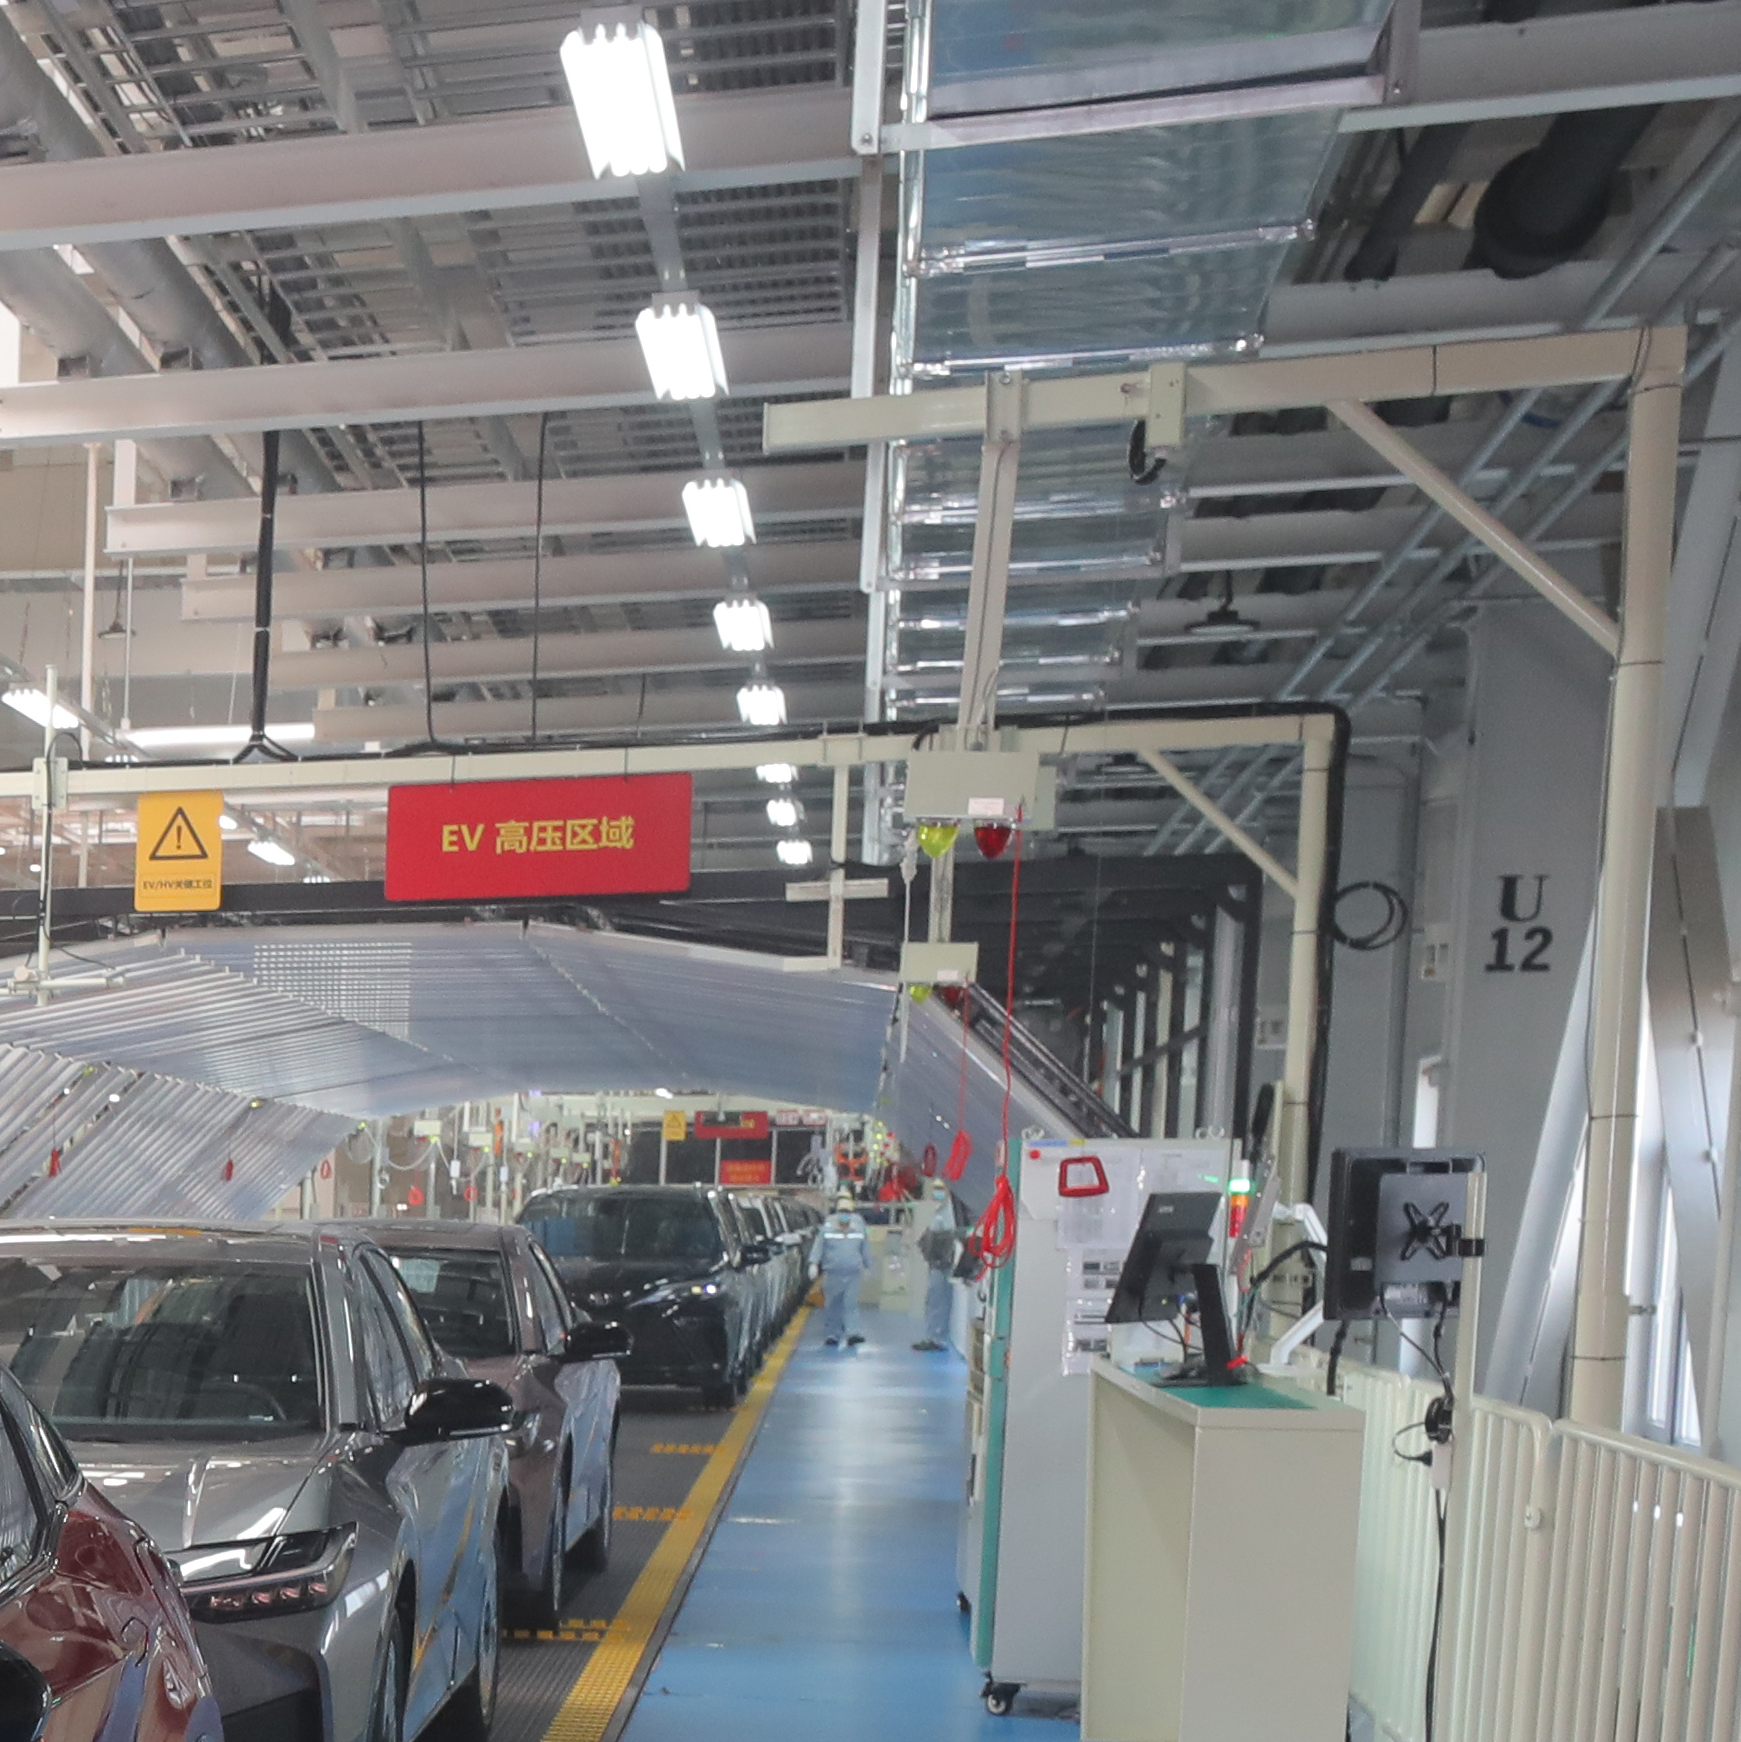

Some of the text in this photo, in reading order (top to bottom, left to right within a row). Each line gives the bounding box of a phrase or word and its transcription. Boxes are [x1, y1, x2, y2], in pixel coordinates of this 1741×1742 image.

[442, 815, 635, 854] EV 高压区域
[1498, 873, 1551, 922] U
[1484, 926, 1554, 972] 12
